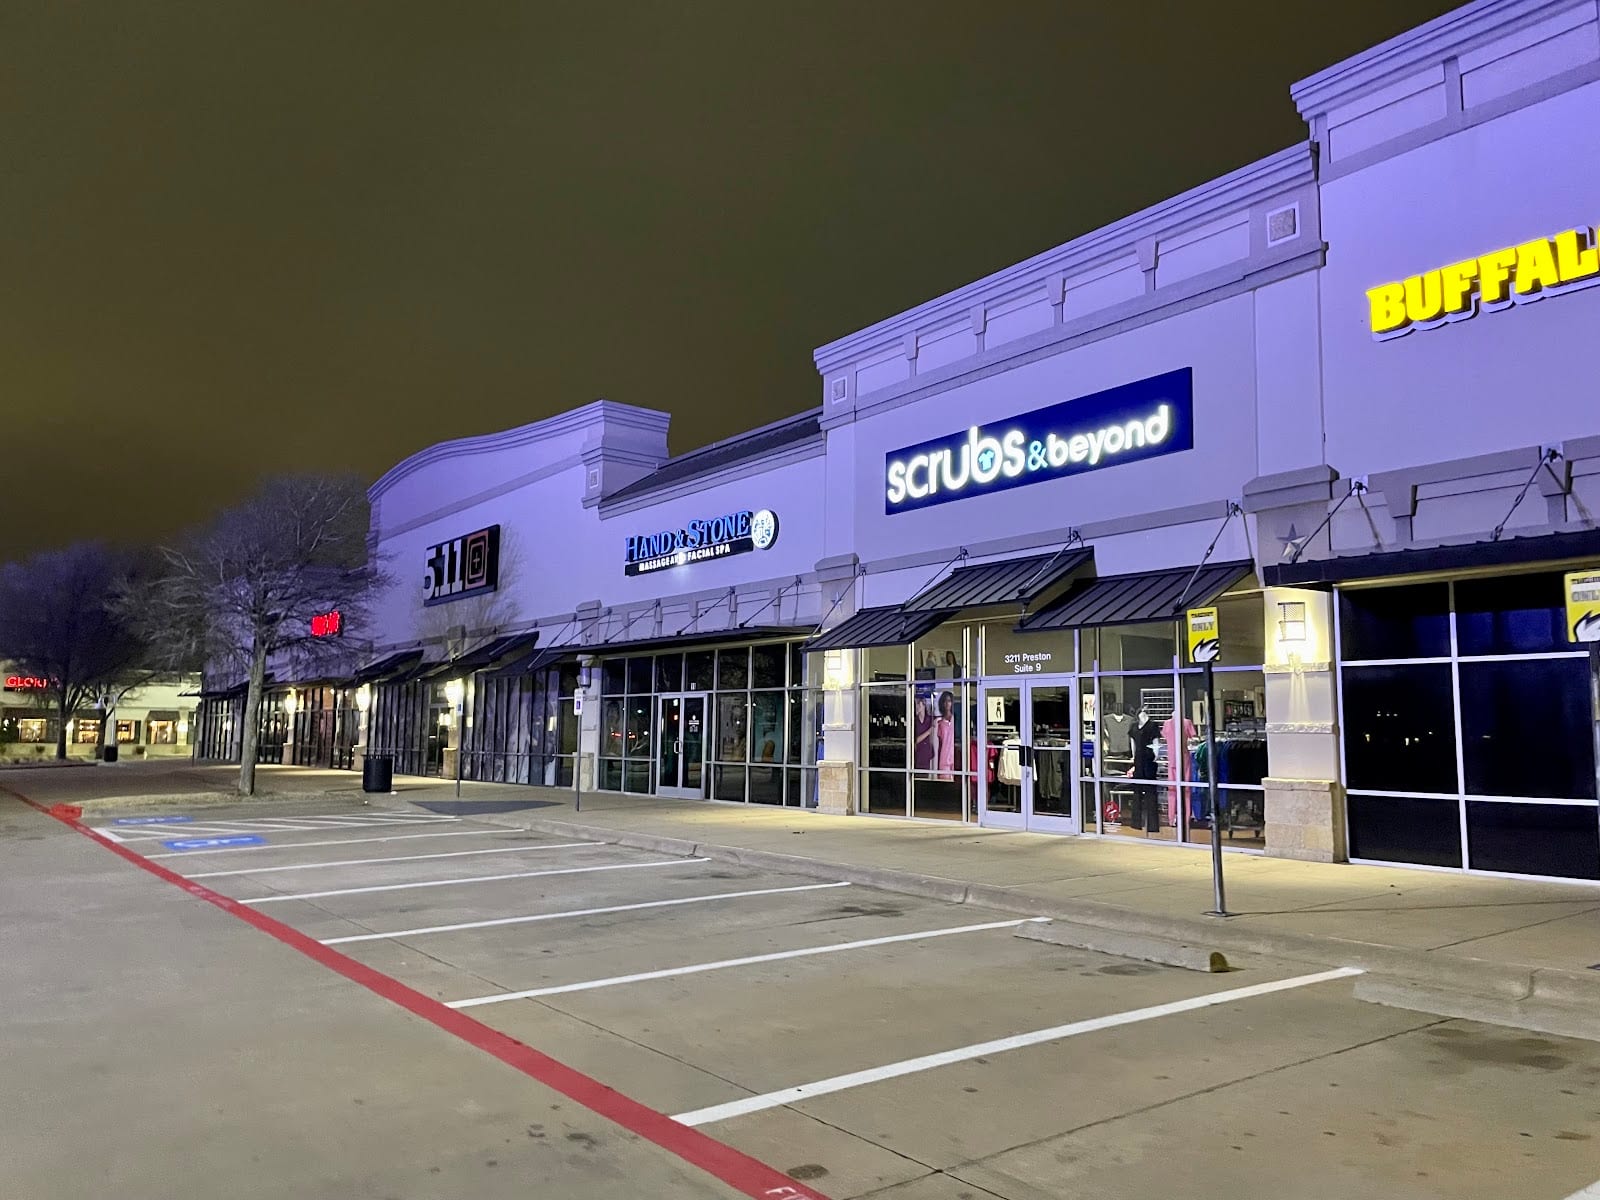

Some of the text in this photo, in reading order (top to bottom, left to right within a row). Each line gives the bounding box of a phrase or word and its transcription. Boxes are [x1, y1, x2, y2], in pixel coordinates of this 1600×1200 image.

[1366, 226, 1600, 333] BUFFAL
[887, 405, 1169, 504] scrubs & beyond
[625, 510, 751, 561] HAND & STONE
[687, 547, 714, 561] FACIAL
[715, 543, 731, 555] SPA
[1004, 652, 1051, 663] 3211 Preston
[1014, 662, 1041, 673] Suite 9
